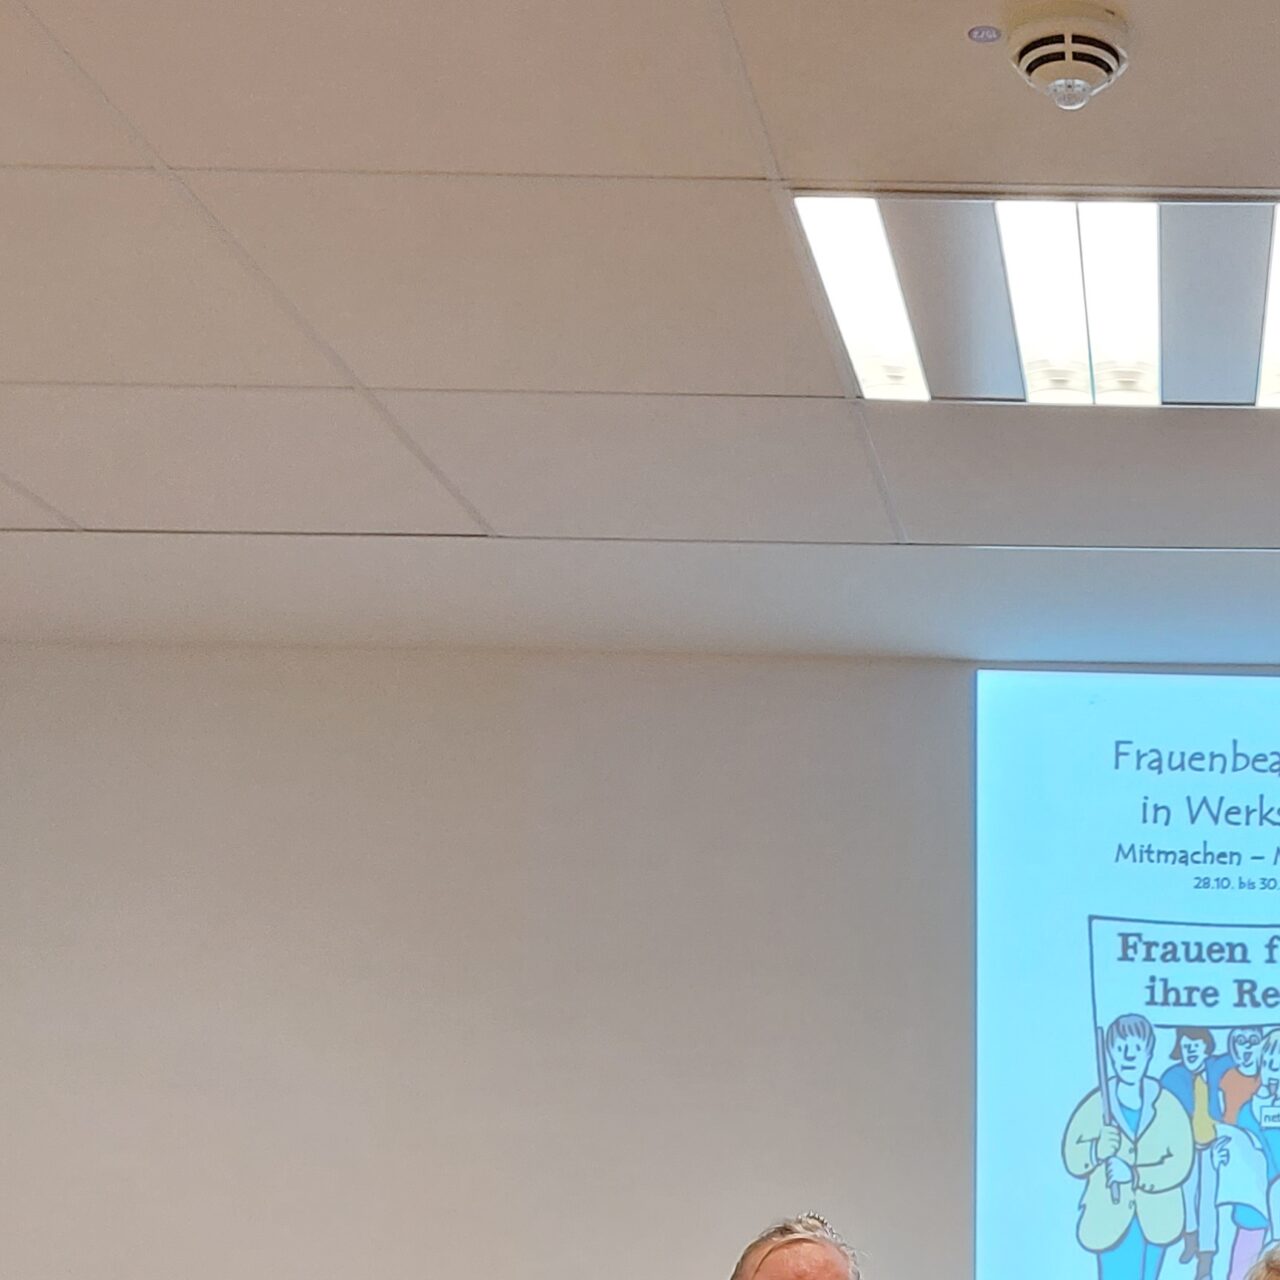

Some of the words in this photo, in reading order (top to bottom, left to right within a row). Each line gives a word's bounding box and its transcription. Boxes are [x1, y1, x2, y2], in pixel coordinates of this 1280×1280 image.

[1142, 796, 1171, 826] in
[1115, 840, 1242, 866] Mitmachen
[1194, 877, 1234, 889] 28.10.
[1238, 876, 1256, 889] bis
[1117, 933, 1251, 964] Frauen
[1145, 975, 1219, 1007] ihre
